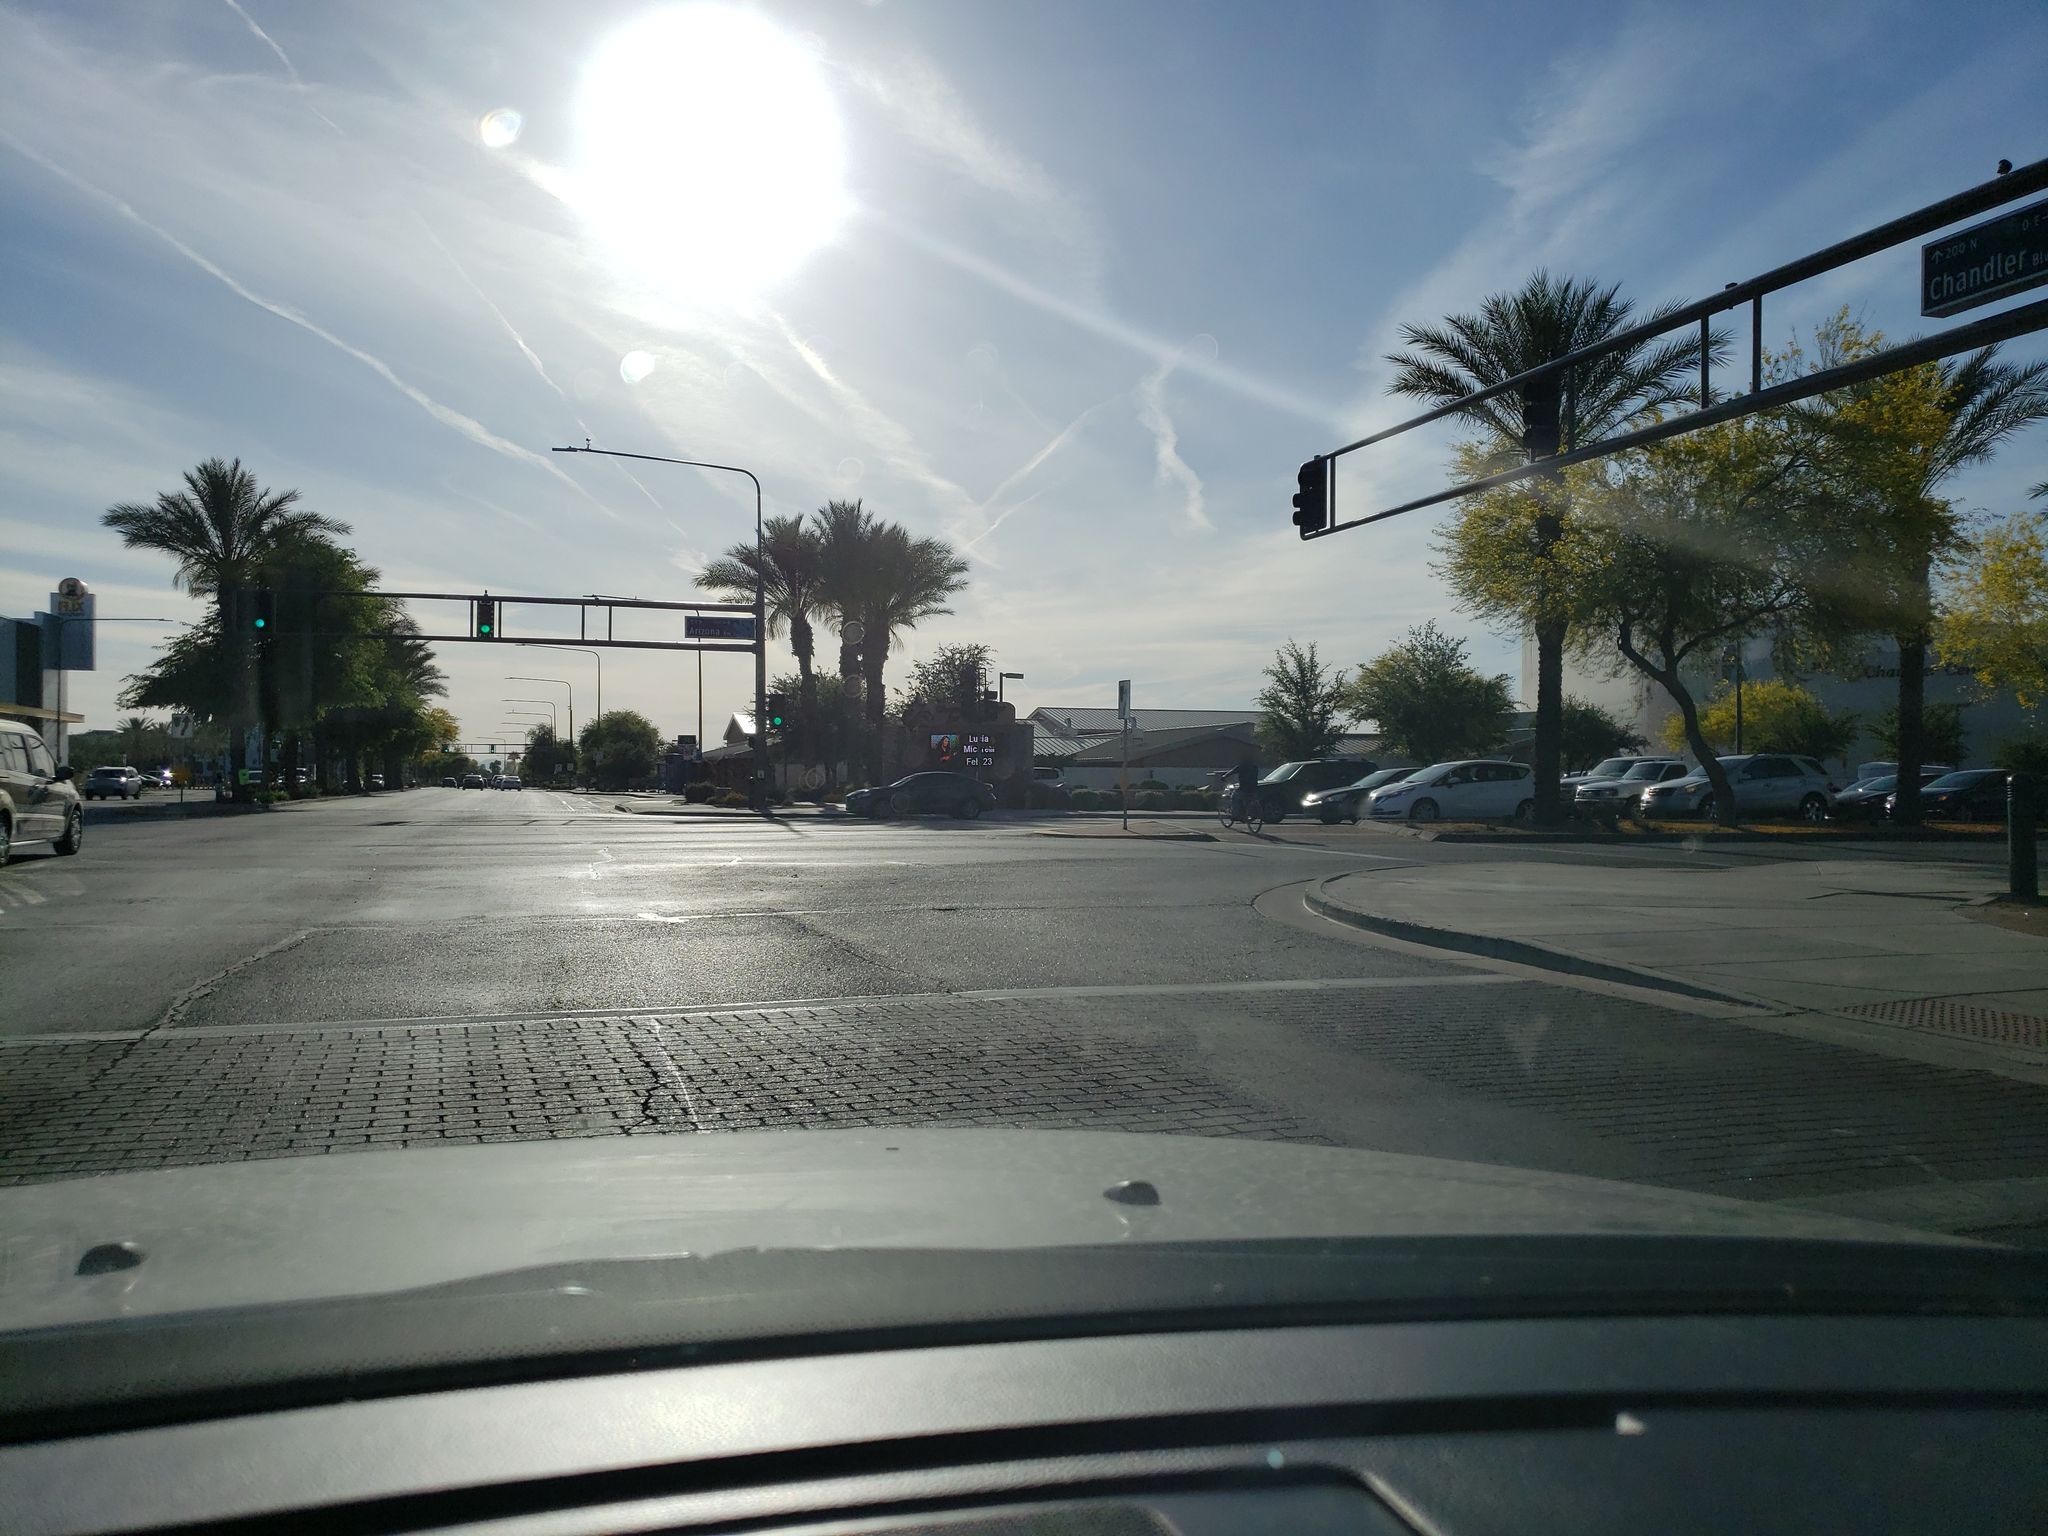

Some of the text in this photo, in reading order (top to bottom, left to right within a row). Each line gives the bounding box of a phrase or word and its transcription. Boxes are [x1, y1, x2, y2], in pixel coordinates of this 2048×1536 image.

[1945, 238, 1978, 259] 200 N
[1929, 249, 2048, 301] Chandler Blv
[689, 626, 720, 636] Arizona
[983, 757, 993, 766] 23
